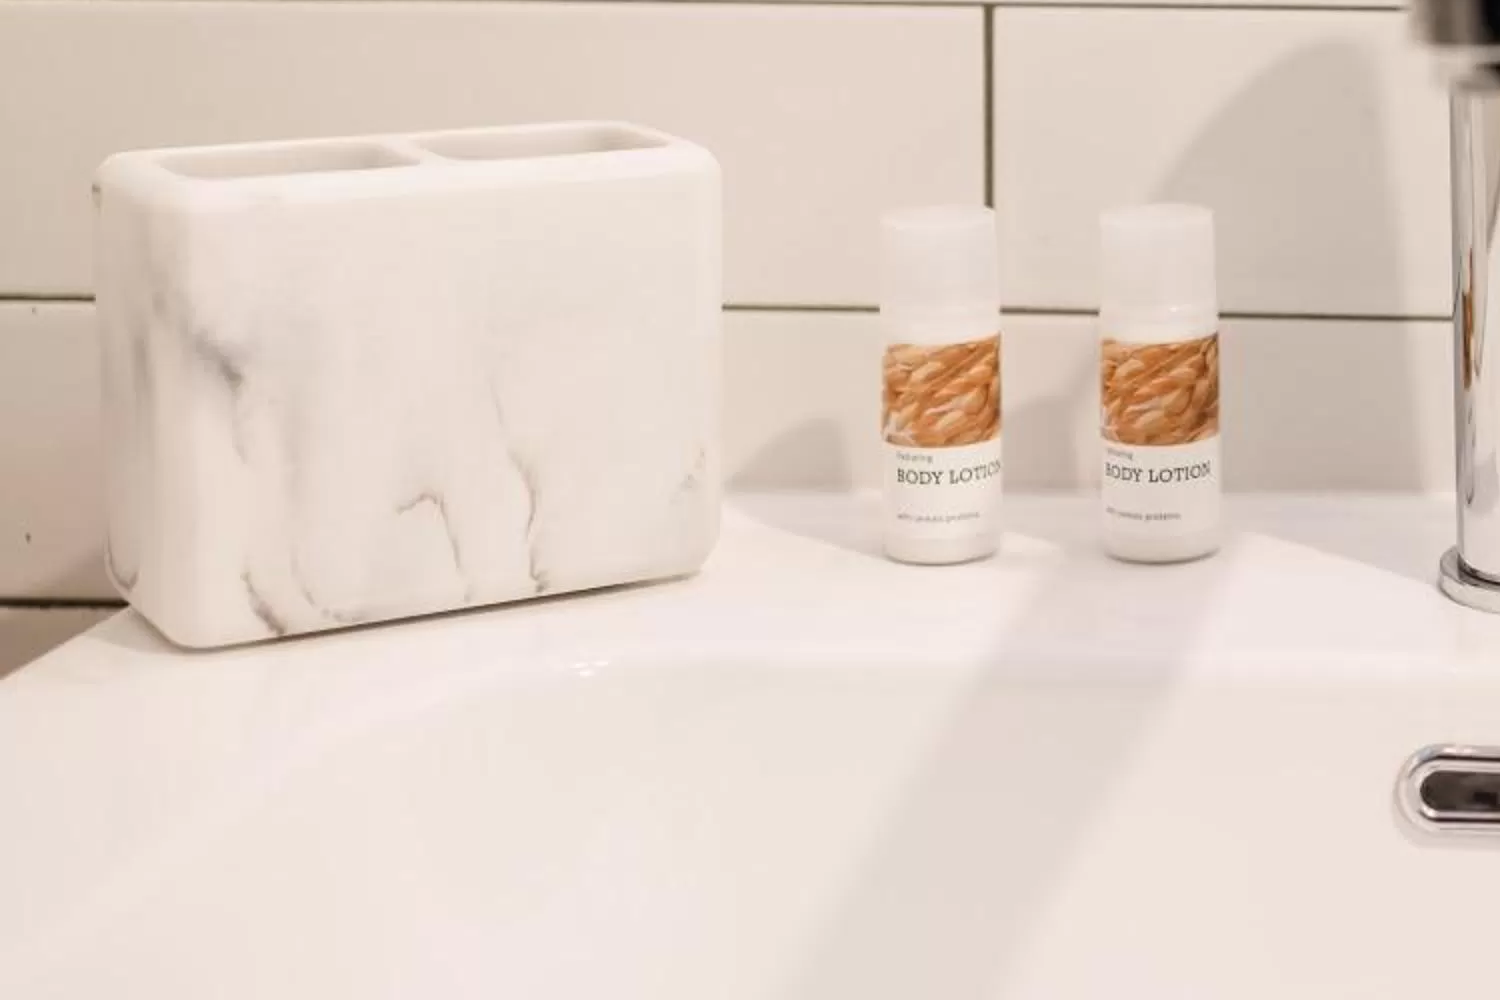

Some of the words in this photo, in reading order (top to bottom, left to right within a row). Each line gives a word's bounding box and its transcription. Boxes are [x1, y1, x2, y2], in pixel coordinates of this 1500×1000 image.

[897, 467, 944, 485] BODY
[949, 459, 1001, 485] LOTION
[1105, 461, 1143, 483] BODY
[1148, 460, 1211, 483] LOTION
